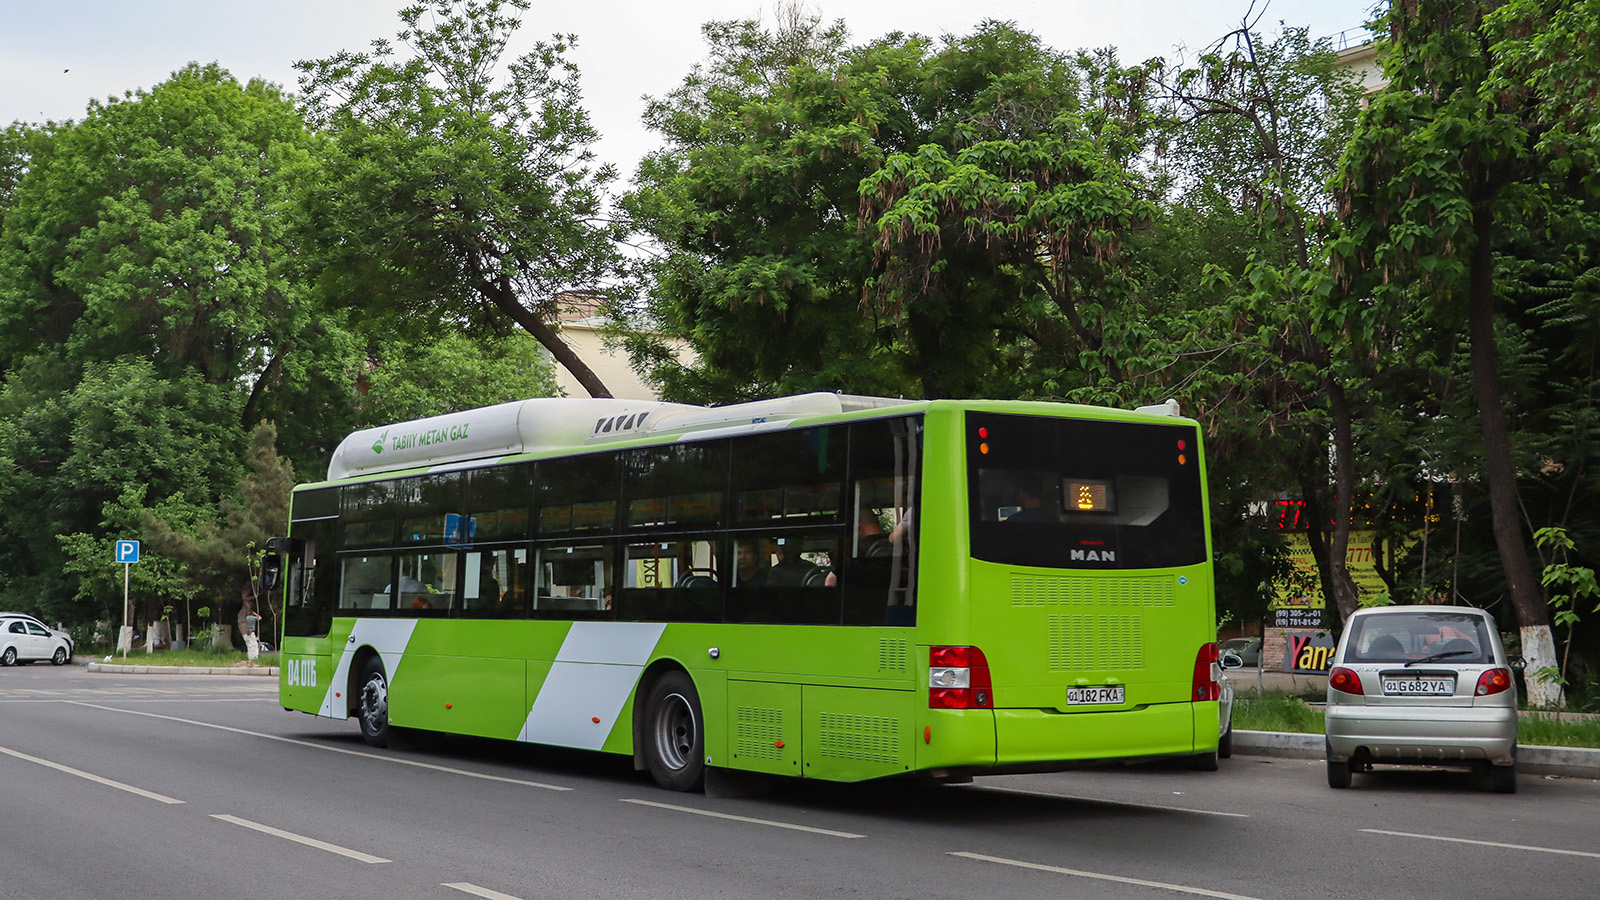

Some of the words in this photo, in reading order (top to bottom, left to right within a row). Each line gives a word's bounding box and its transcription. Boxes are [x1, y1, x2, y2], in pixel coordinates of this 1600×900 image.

[392, 433, 418, 451] TABIIY
[419, 427, 449, 447] METAN
[450, 423, 470, 441] GAZ
[121, 543, 134, 560] P
[1070, 549, 1115, 562] MAN
[1348, 548, 1372, 563] 777
[1275, 609, 1289, 618] (99)
[288, 659, 300, 686] 04
[301, 659, 317, 687] 016
[1079, 689, 1097, 702] 182
[1099, 689, 1118, 702] FKA
